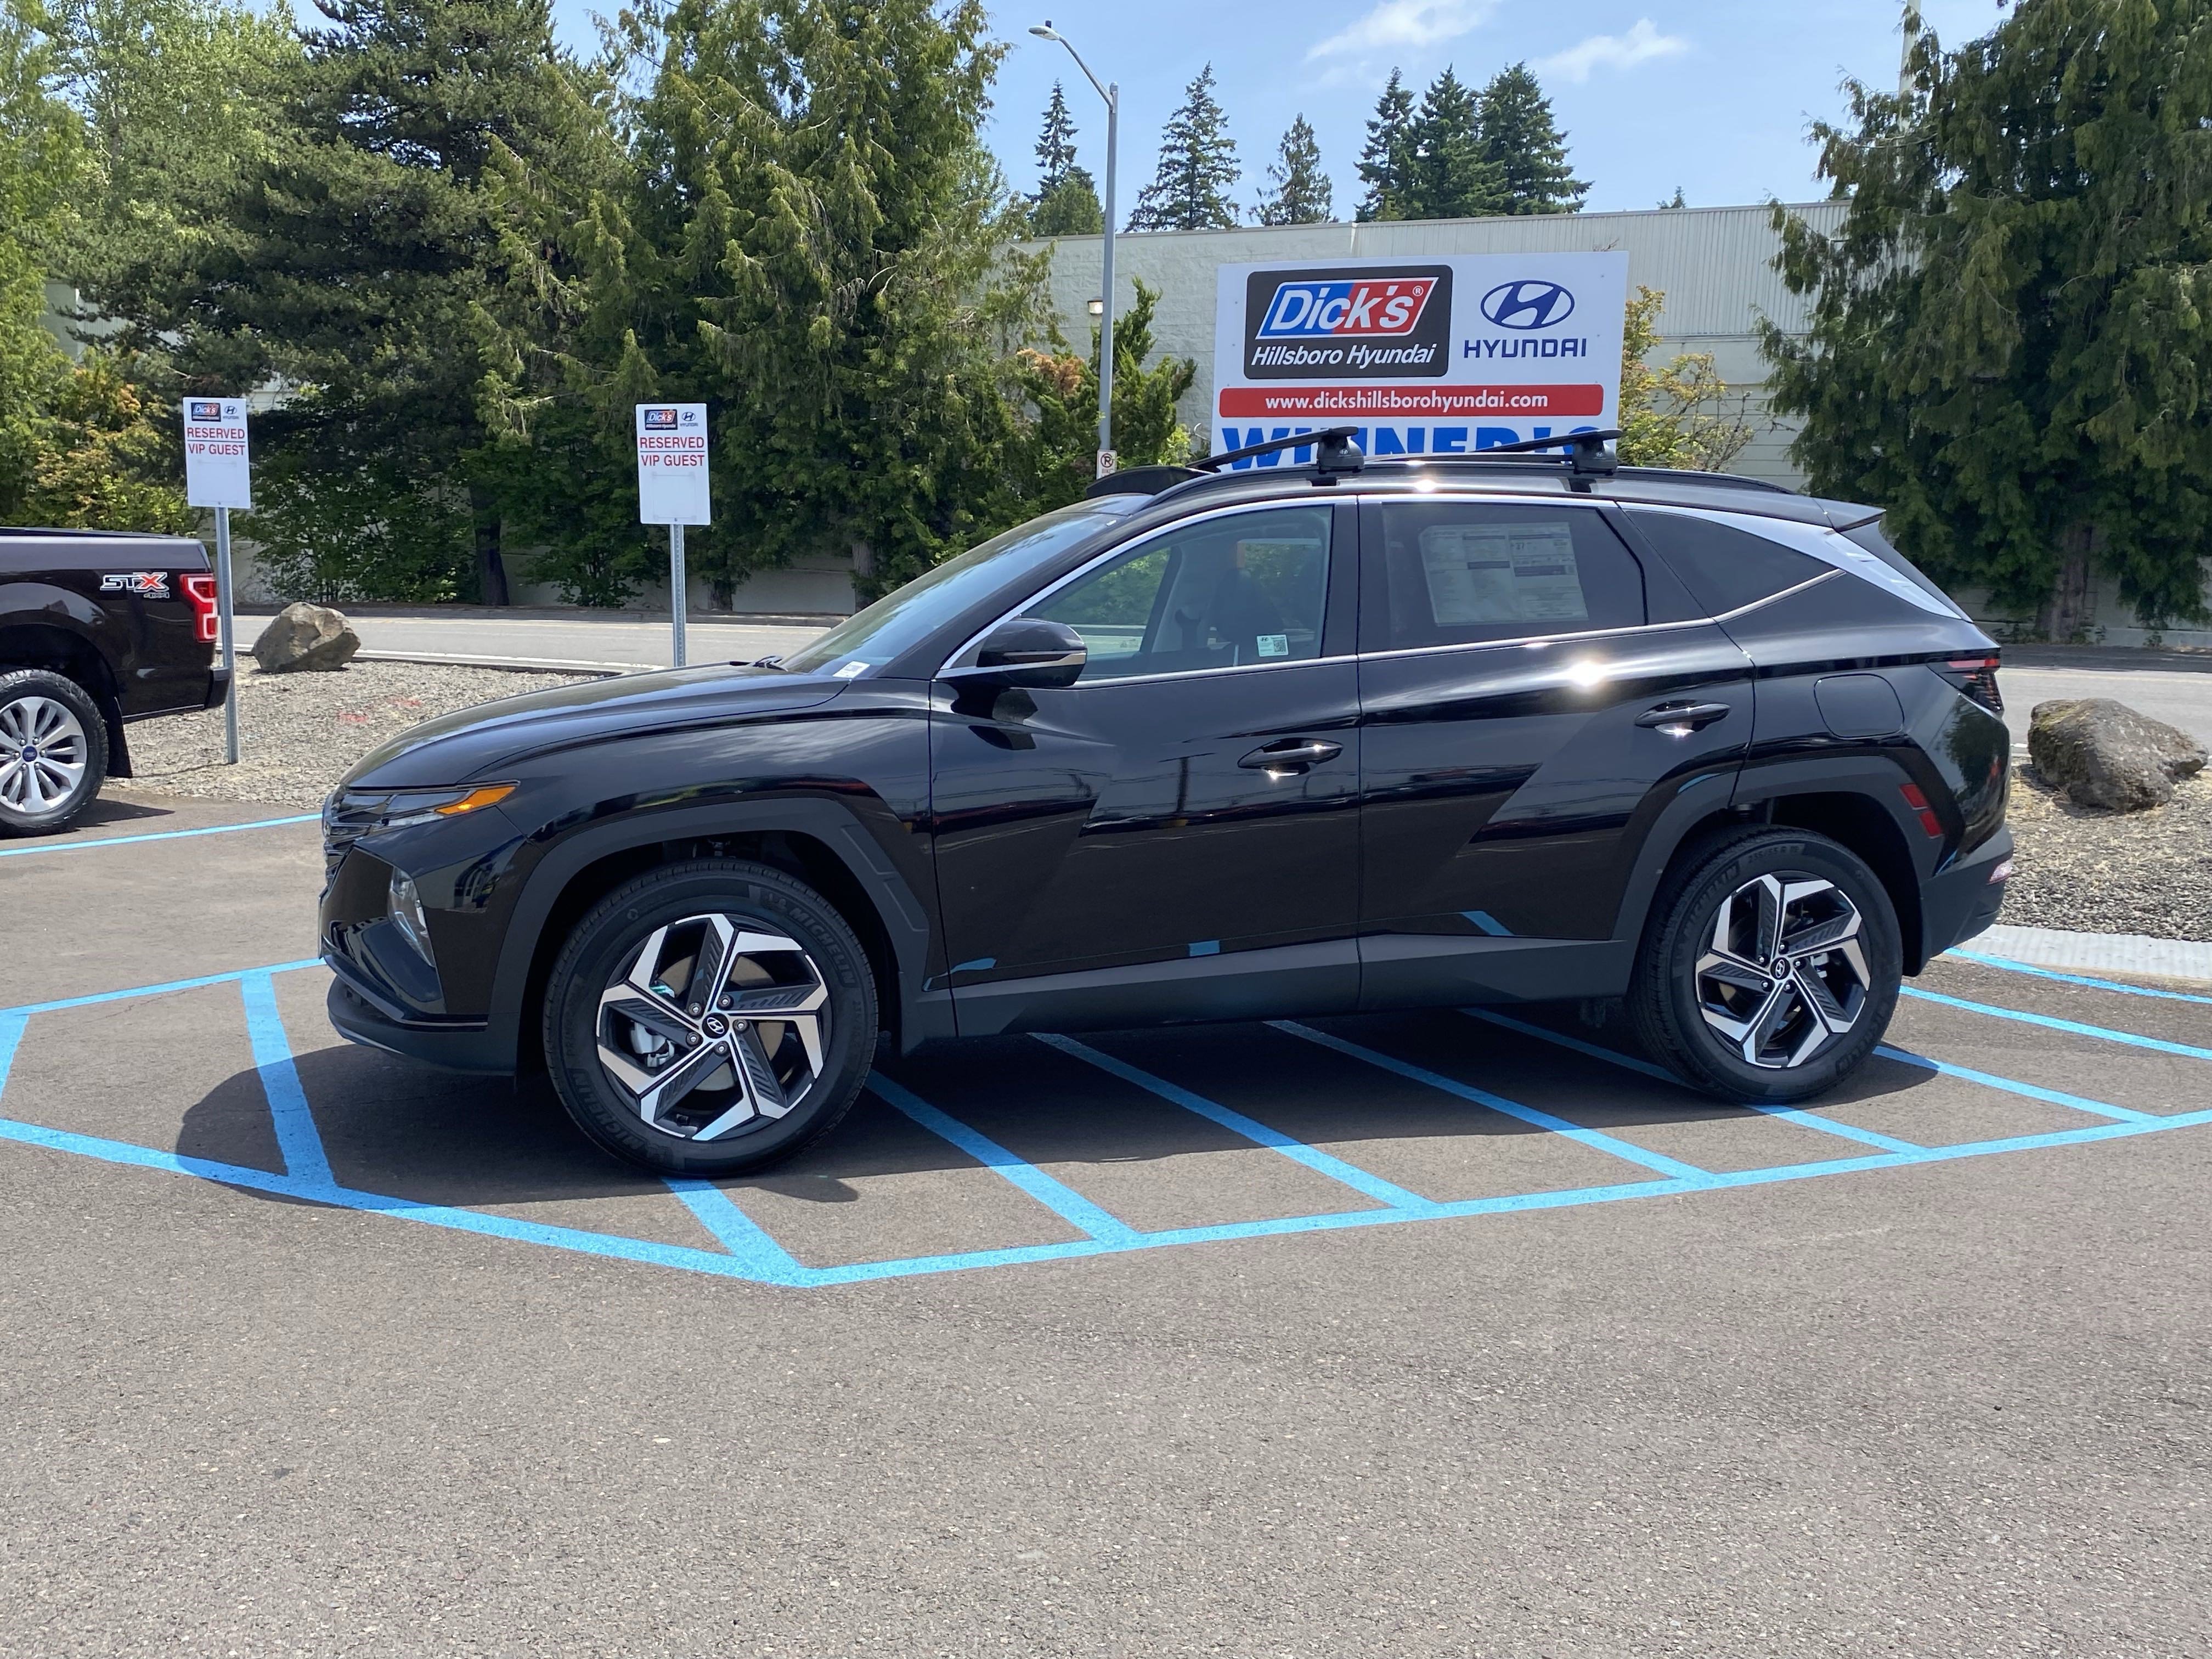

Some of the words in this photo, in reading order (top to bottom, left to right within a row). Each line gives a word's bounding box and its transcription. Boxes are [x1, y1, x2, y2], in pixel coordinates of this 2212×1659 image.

[1269, 285, 1414, 330] Dick's
[1251, 345, 1343, 366] Hillsboro
[1346, 343, 1437, 369] Hyundai
[1464, 338, 1587, 358] HYUNDAI
[1265, 389, 1549, 413] www.dickshillsborohyundai.com
[648, 412, 673, 421] Dick's
[187, 427, 245, 439] RESERVED
[640, 437, 704, 449] RESERVED
[188, 443, 205, 454] VIP
[208, 443, 246, 456] GUEST
[641, 455, 659, 466] VIP
[664, 454, 705, 466] GUEST
[99, 572, 170, 593] STX
[788, 907, 857, 985] MICHELIN
